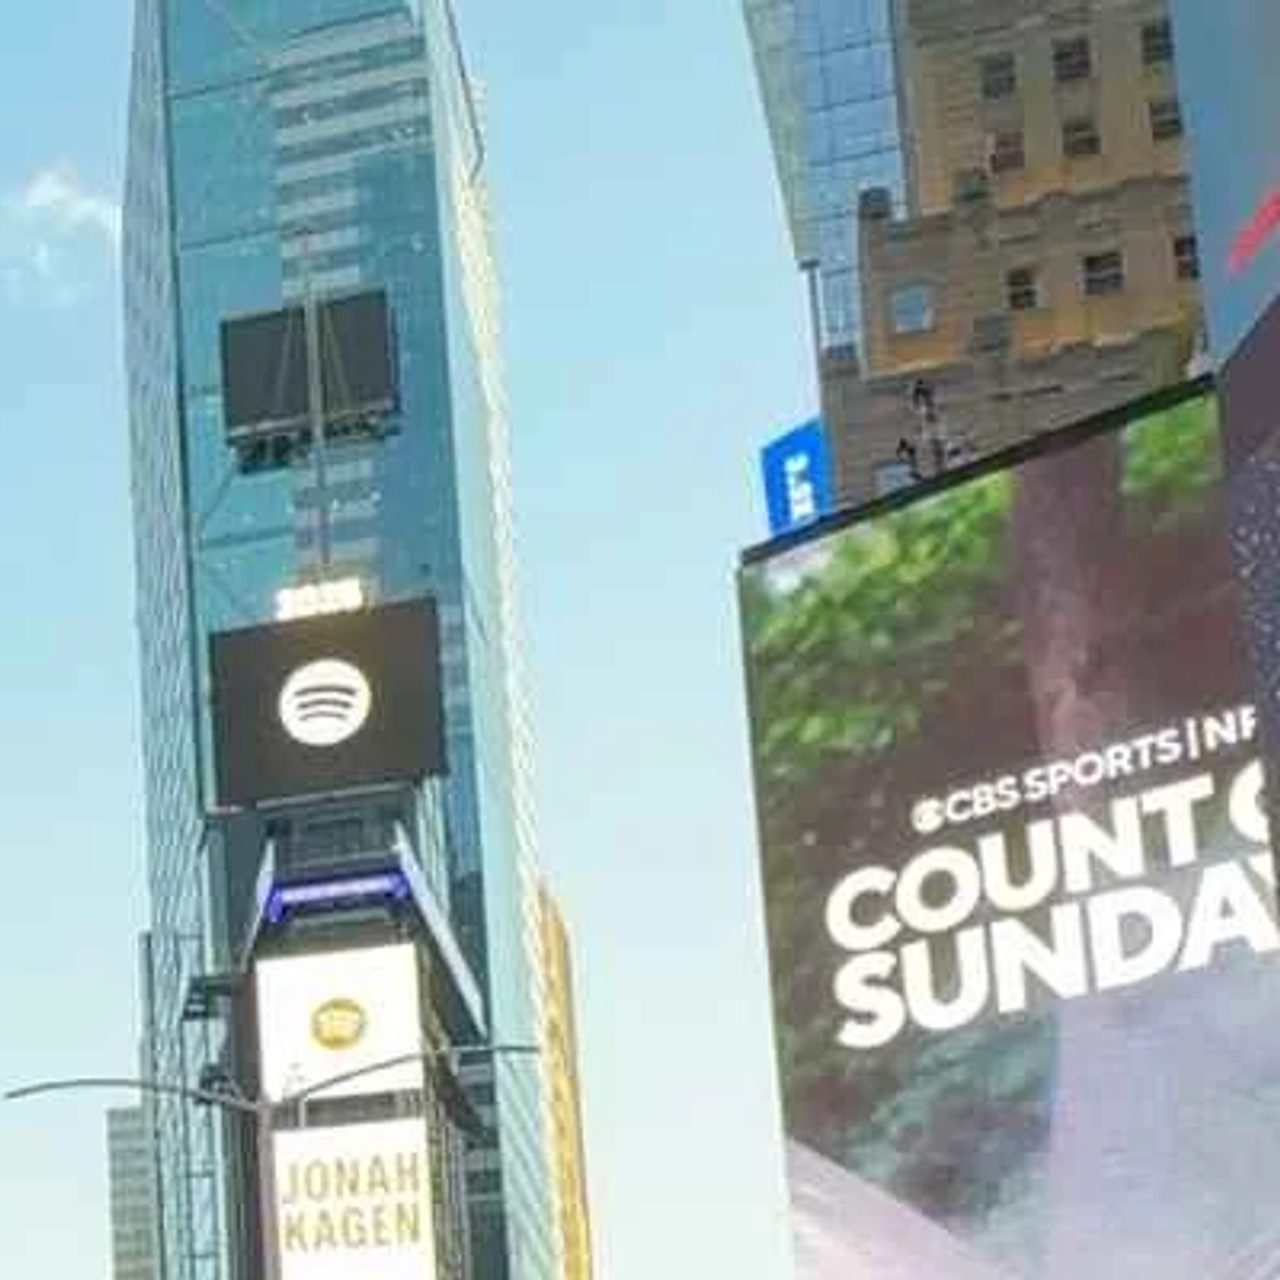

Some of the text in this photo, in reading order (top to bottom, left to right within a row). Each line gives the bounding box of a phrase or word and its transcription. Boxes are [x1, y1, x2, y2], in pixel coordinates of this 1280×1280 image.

[948, 775, 1023, 822] CBS
[1024, 728, 1183, 800] SPORTS
[826, 772, 1215, 951] COUNT
[281, 1151, 420, 1205] JONAH
[283, 1203, 421, 1253] KAGEN
